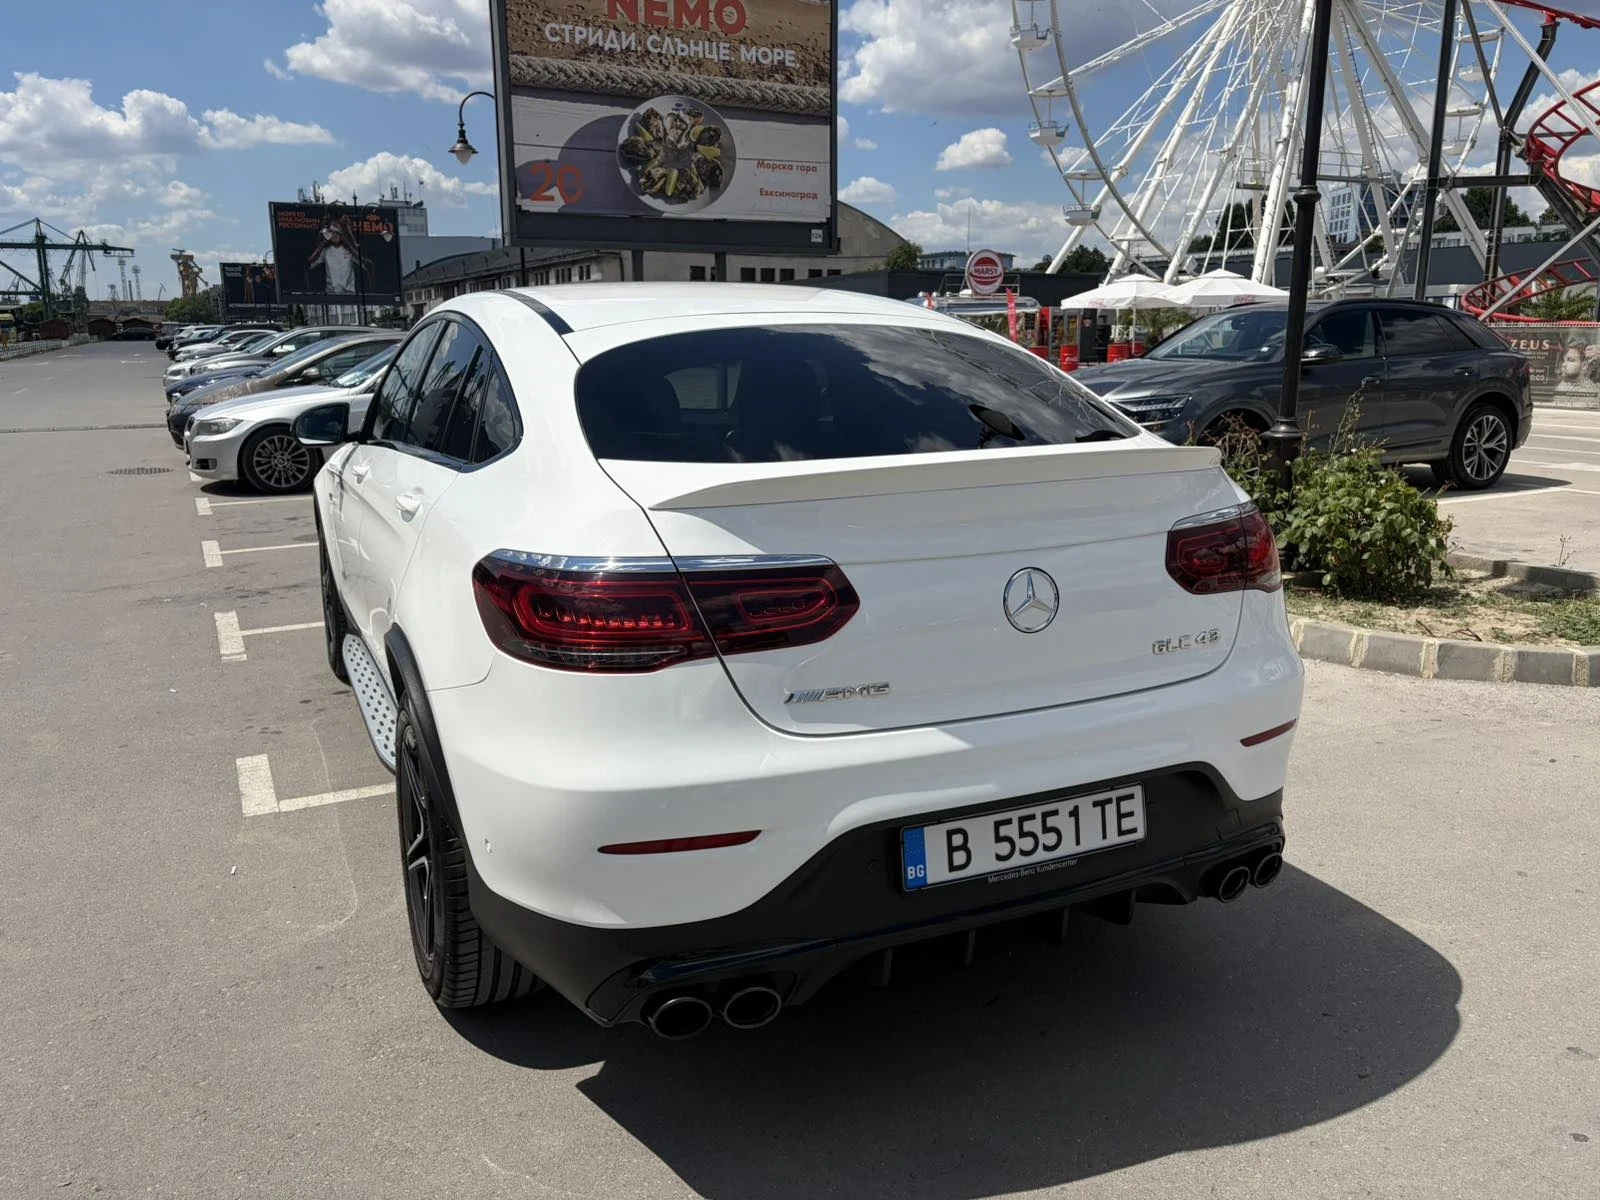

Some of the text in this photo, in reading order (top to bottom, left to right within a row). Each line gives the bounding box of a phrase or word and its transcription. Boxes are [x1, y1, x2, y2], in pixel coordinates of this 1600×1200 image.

[607, 0, 746, 35] NEMO
[544, 22, 642, 52] СТРИДИ.
[756, 160, 793, 172] Морска
[759, 187, 818, 200] Евксиноград
[1510, 339, 1550, 351] ZEUS
[1152, 634, 1191, 655] GLC
[945, 793, 1138, 873] B 5551 TE
[907, 864, 925, 880] BG
[988, 858, 1078, 884] Mercedes-Benz Kundencenter
